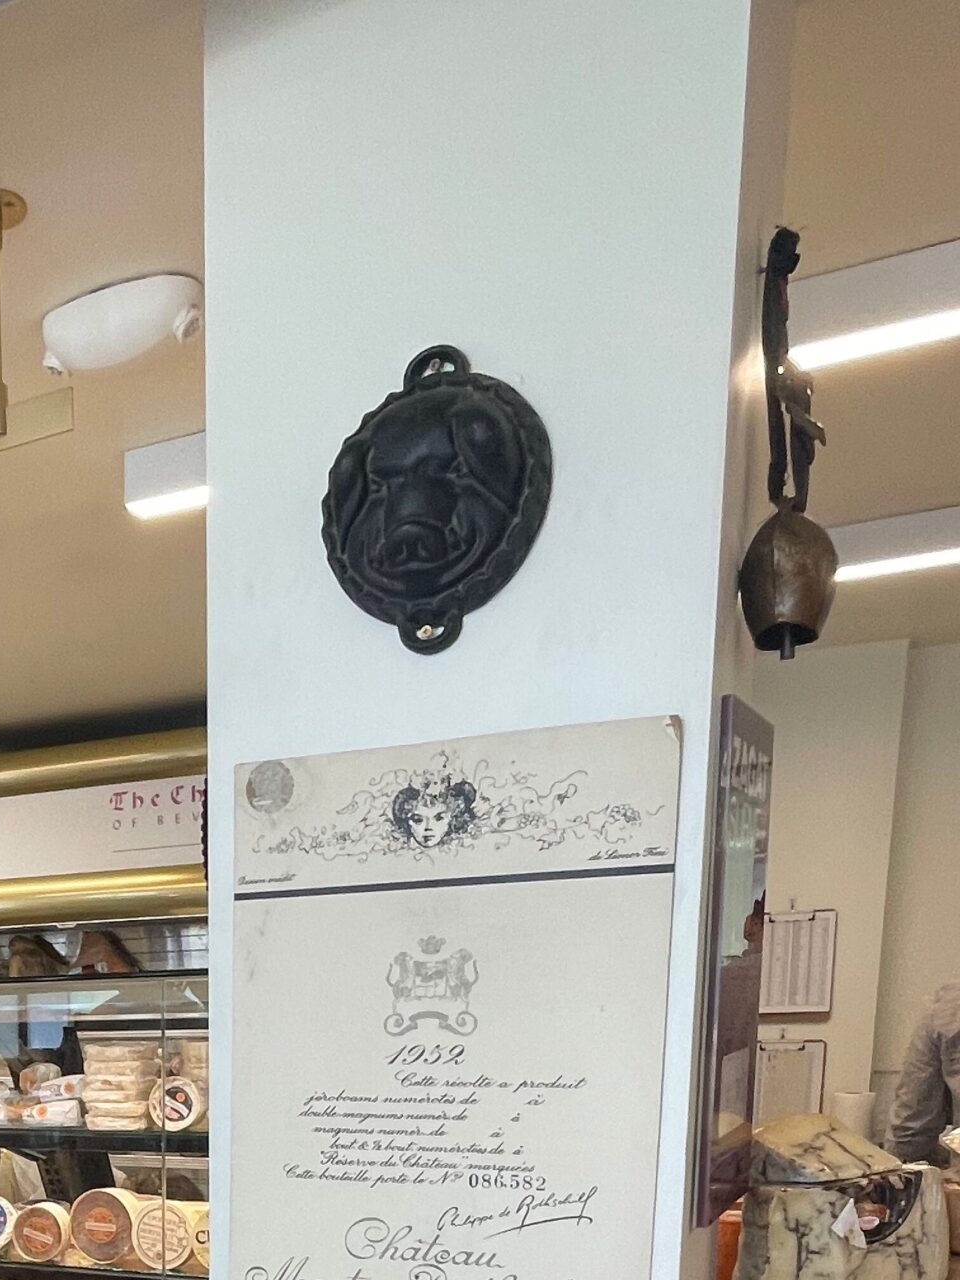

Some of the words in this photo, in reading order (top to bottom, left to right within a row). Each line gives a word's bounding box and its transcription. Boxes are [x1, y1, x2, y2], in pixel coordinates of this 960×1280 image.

[109, 791, 160, 811] The
[112, 818, 137, 830] OF
[384, 1043, 465, 1066] 1952
[394, 1070, 439, 1088] Cette
[512, 1074, 588, 1094] produit
[458, 1091, 480, 1105] de
[451, 1107, 469, 1121] de
[311, 1126, 375, 1138] magnums
[282, 1162, 317, 1179] Cette
[318, 1167, 370, 1182] bouteille
[370, 1172, 410, 1188] porte
[344, 1216, 505, 1269] Château
